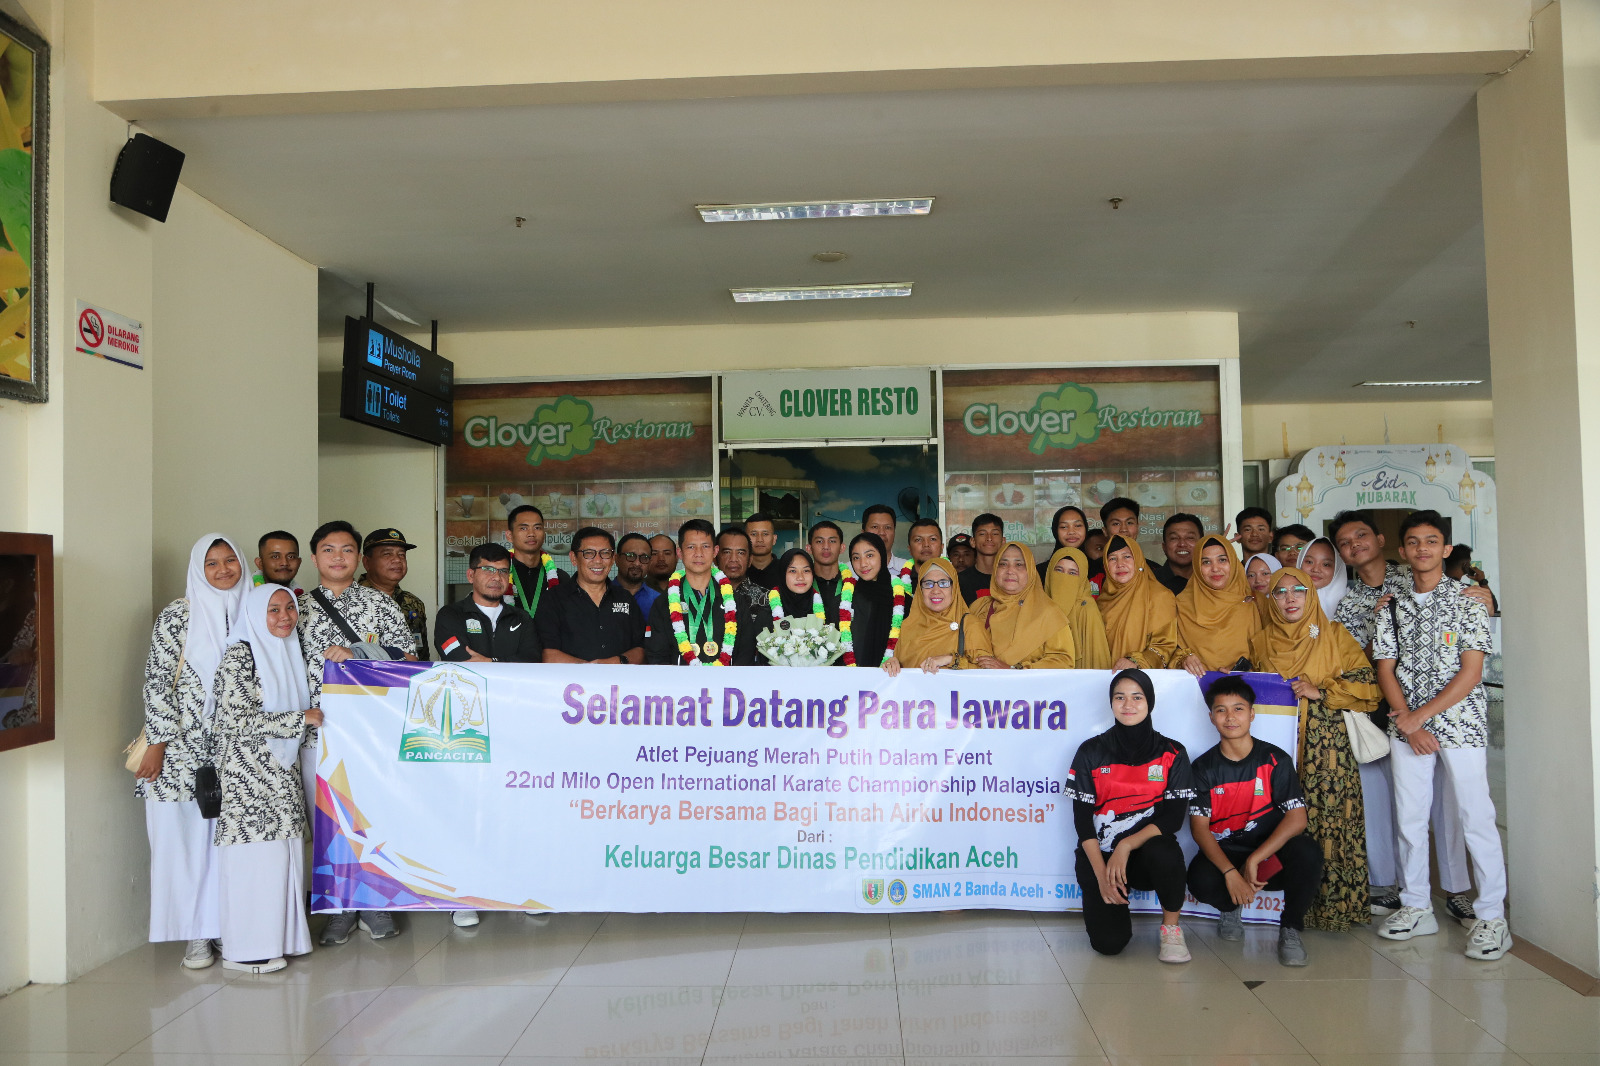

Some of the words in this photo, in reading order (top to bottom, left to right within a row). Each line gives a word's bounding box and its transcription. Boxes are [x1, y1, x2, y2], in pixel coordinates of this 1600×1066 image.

[108, 325, 140, 343] DILARANG
[108, 336, 139, 354] MEROKOK
[384, 337, 420, 368] Musholla
[384, 359, 401, 375] Prayer
[401, 367, 417, 381] Room
[384, 386, 407, 410] Toilet
[737, 396, 754, 418] WANITA
[755, 390, 777, 417] CHATERING
[780, 388, 852, 417] CLOVER
[858, 386, 919, 415] RESTO
[964, 404, 1075, 434] Clover
[1098, 405, 1202, 432] Restoran
[464, 416, 571, 447] Clover
[593, 416, 694, 444] Restoran
[1361, 470, 1408, 490] Eid
[1356, 490, 1417, 507] MUBARAK
[544, 521, 568, 529] Juice
[633, 520, 659, 528] Juice
[1140, 512, 1165, 521] Nasi
[446, 535, 487, 547] Coklat
[1004, 530, 1027, 541] arik
[561, 683, 713, 727] Selamat
[722, 687, 849, 738] Datang
[858, 690, 937, 730] Para
[945, 690, 1068, 730] Jawara
[405, 751, 484, 761] PANCACITA
[635, 746, 679, 763] Atlet
[685, 746, 758, 767] Pejuang
[764, 748, 819, 765] Merah
[827, 748, 873, 765] Putih
[879, 749, 937, 766] Dalam
[944, 748, 992, 765] Event
[505, 770, 555, 789] 22nd
[561, 771, 600, 790] Milo
[606, 772, 654, 793] Open
[661, 773, 776, 791] International
[783, 774, 842, 792] Karate
[848, 775, 976, 796] Championship
[982, 775, 1060, 797] Malaysia
[569, 799, 671, 825] “Berkarya
[679, 800, 767, 821] Bersama
[774, 801, 818, 826] Bagi
[825, 802, 884, 822] Tanah
[890, 802, 943, 823] Airku
[949, 803, 1055, 824] Indonesia”
[797, 830, 825, 843] Dari
[605, 844, 700, 875] Keluarga
[708, 845, 771, 869] Besar
[778, 846, 836, 870] Dinas
[844, 846, 960, 871] Pendidikan
[966, 845, 1019, 870] Aceh
[913, 883, 950, 899] SMAN
[954, 881, 962, 897] 2
[965, 881, 1007, 897] Banda
[1010, 881, 1044, 898] Aceh
